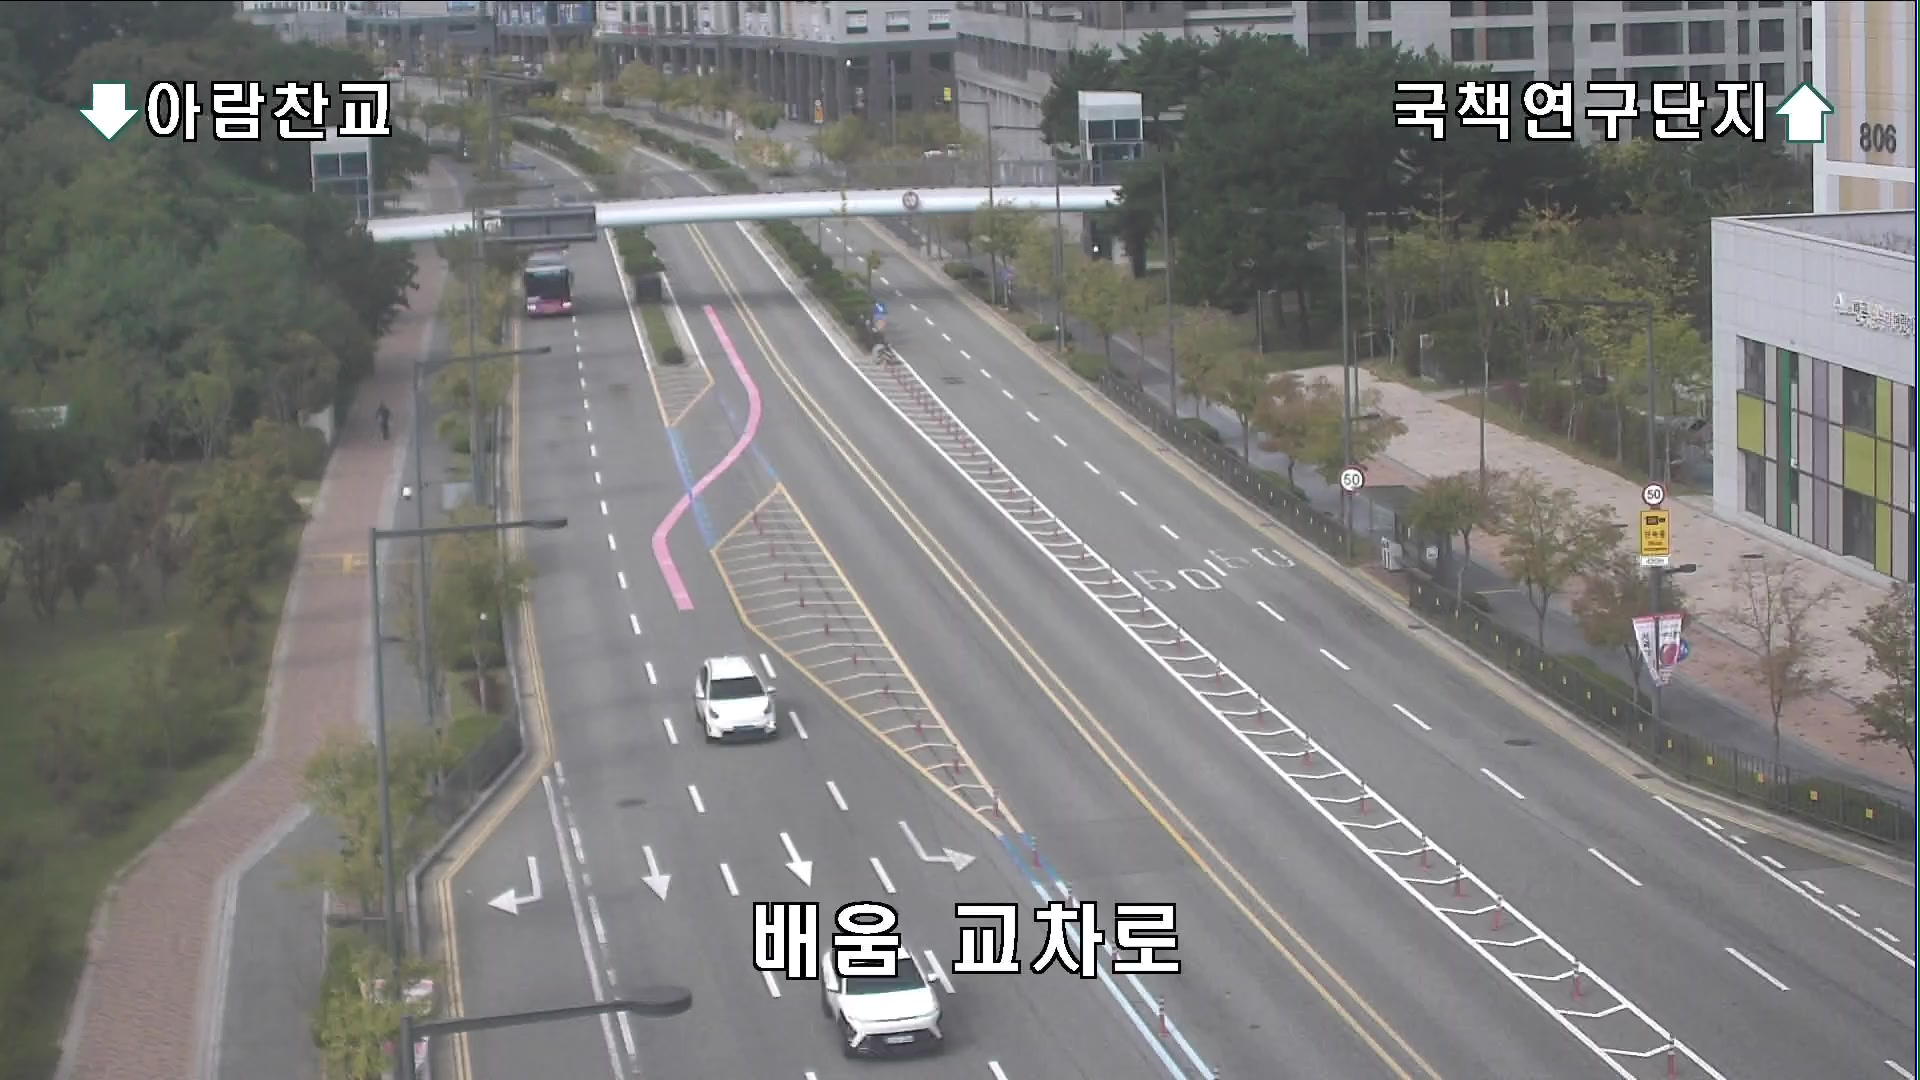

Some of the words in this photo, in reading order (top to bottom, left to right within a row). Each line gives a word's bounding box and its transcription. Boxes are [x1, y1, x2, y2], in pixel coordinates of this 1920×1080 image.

[1859, 121, 1897, 154] 806
[1343, 473, 1361, 486] 50
[1646, 488, 1661, 500] 50
